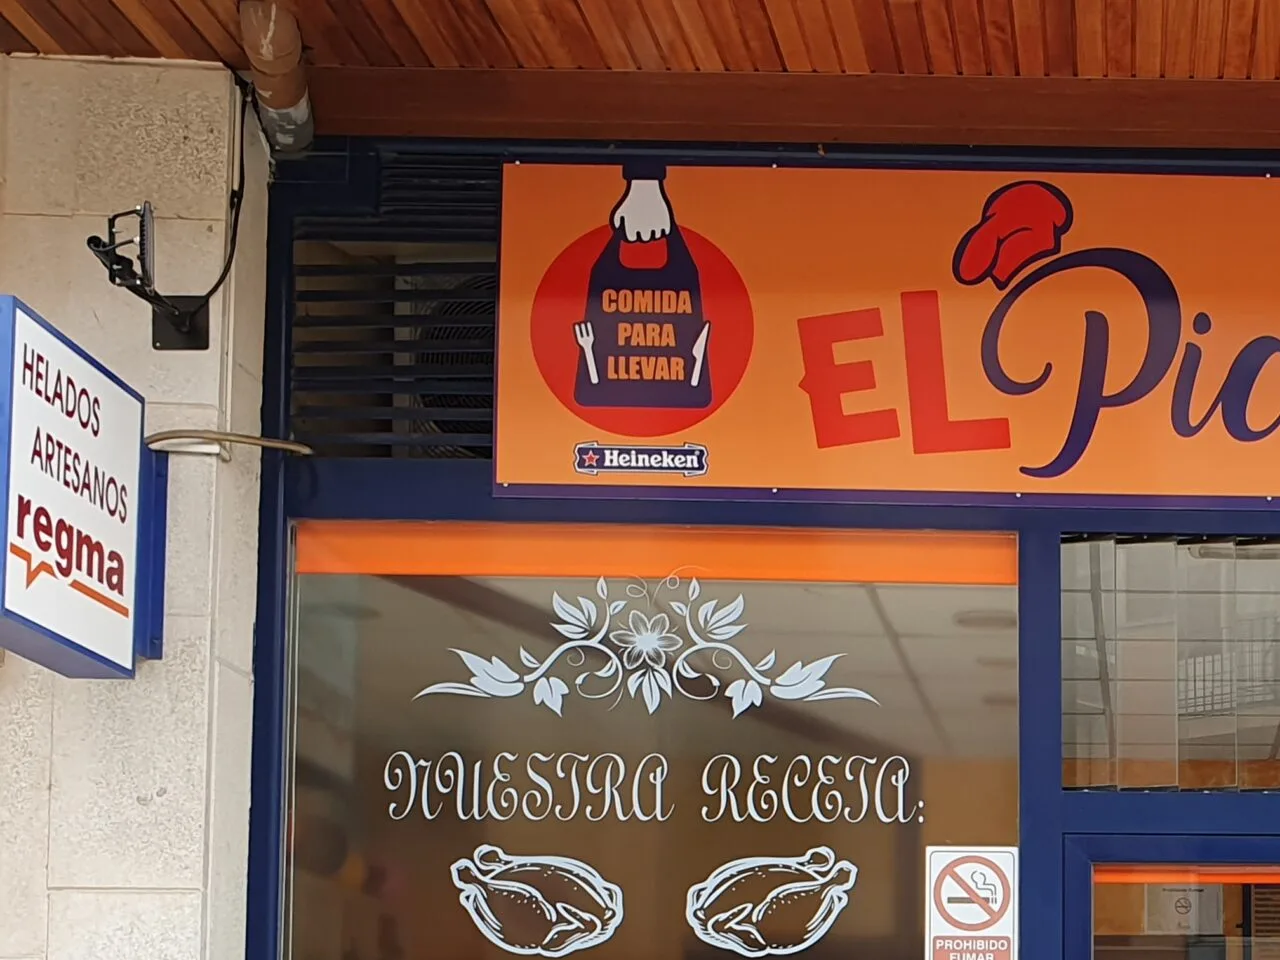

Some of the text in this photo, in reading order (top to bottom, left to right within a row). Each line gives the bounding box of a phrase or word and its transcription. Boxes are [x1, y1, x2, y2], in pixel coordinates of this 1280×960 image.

[602, 289, 692, 314] COMIDA
[618, 323, 676, 347] PARA
[22, 343, 101, 437] HELADOS
[607, 356, 685, 380] LLEVAR
[797, 289, 1011, 454] EL
[30, 426, 127, 524] ARTESANOS
[603, 449, 700, 468] Heineken
[17, 493, 125, 597] regma
[383, 750, 925, 823] NUESTRA RECETA:
[936, 939, 1008, 950] PROHIBIDO
